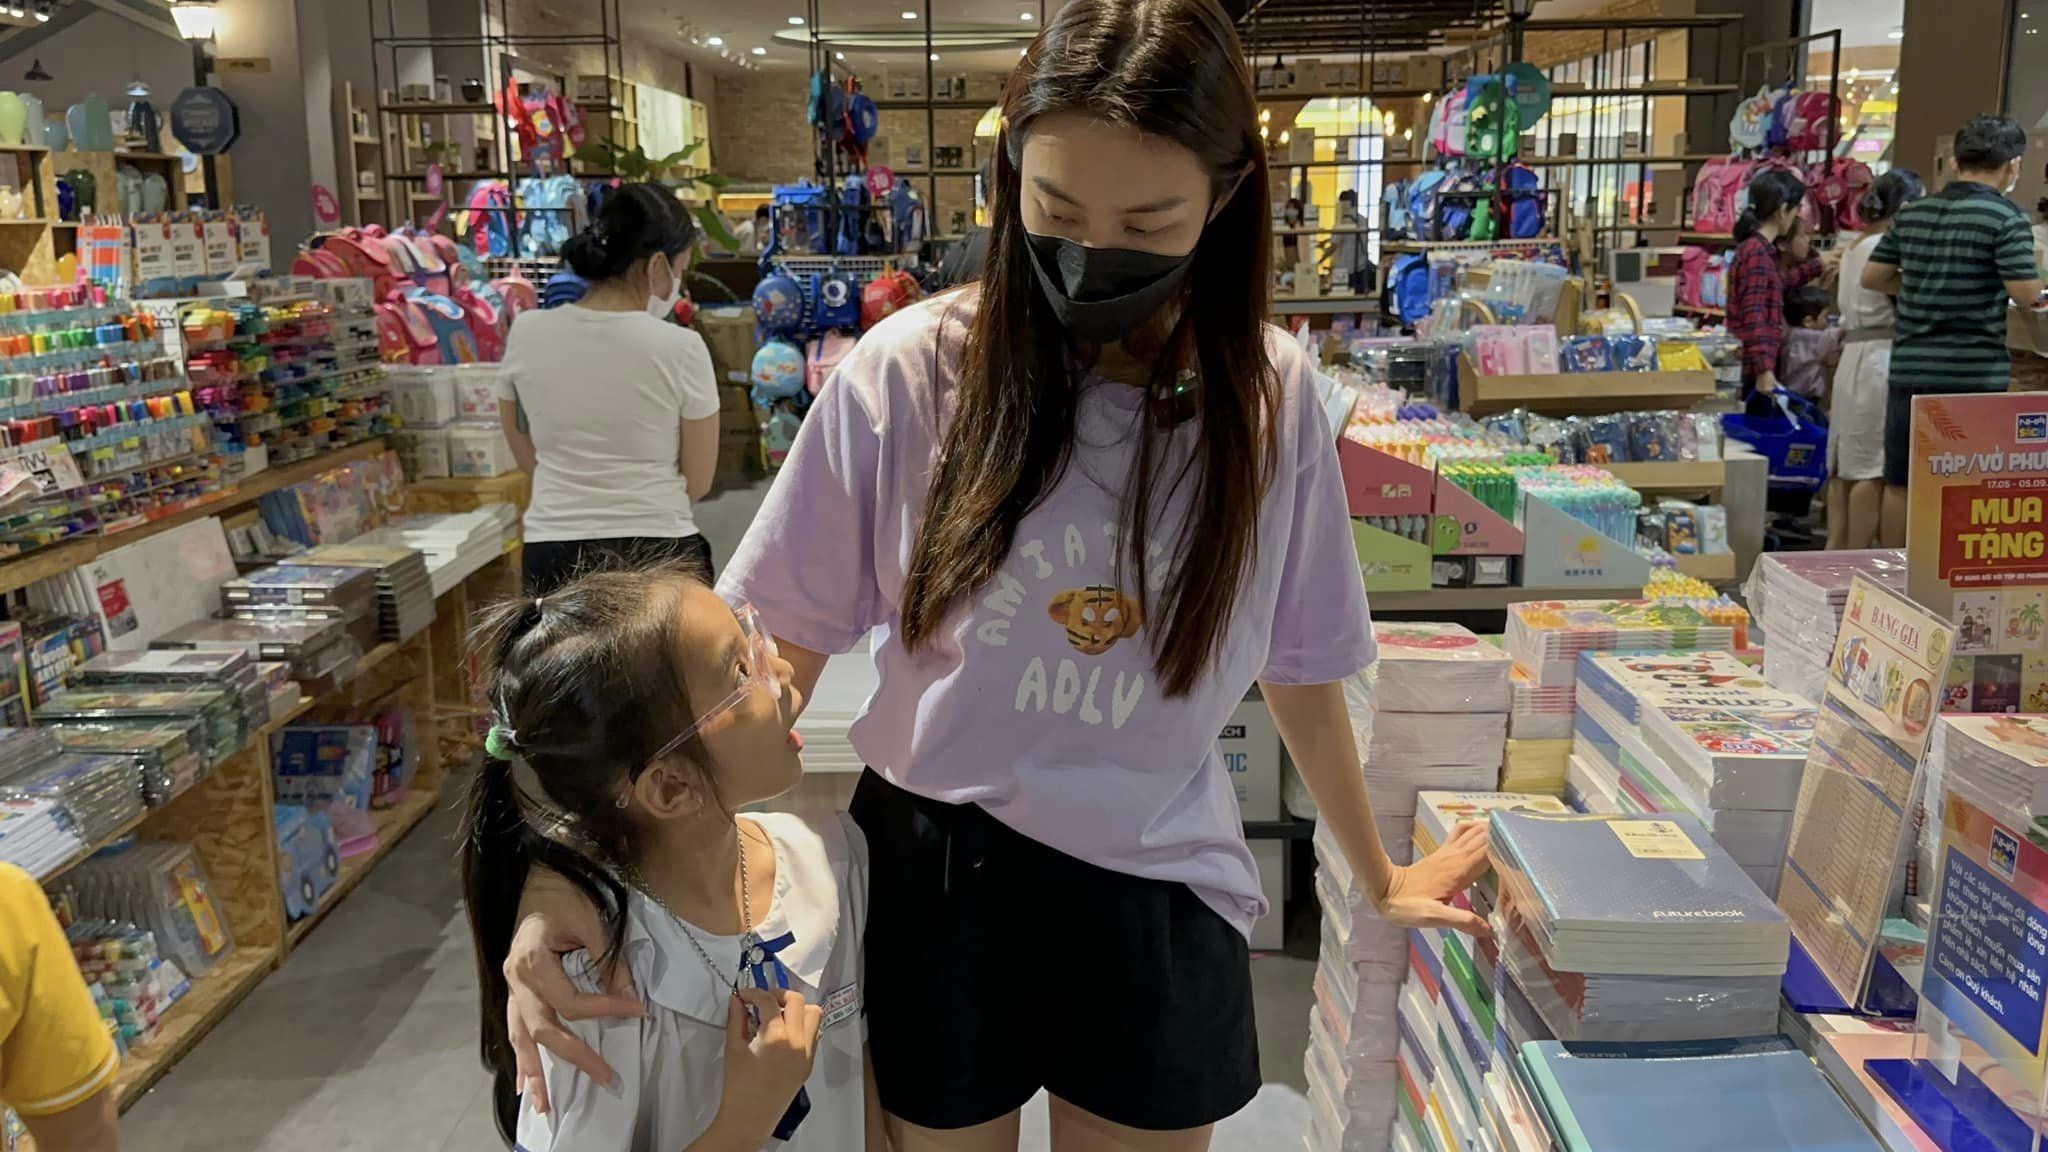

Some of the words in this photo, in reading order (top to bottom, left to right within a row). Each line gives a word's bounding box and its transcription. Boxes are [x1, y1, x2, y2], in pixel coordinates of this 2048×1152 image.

[1987, 480, 2011, 489] 17.05
[1970, 496, 2043, 525] MUA
[1957, 527, 2045, 565] TẶNG
[976, 571, 1027, 646] AM
[1063, 523, 1087, 569] A
[1015, 656, 1145, 730] ADLV
[1664, 697, 1793, 708] Campus
[2026, 916, 2048, 940] đóng
[2026, 932, 2046, 956] lòng
[2007, 953, 2024, 973] mua
[1965, 974, 1980, 995] Quý
